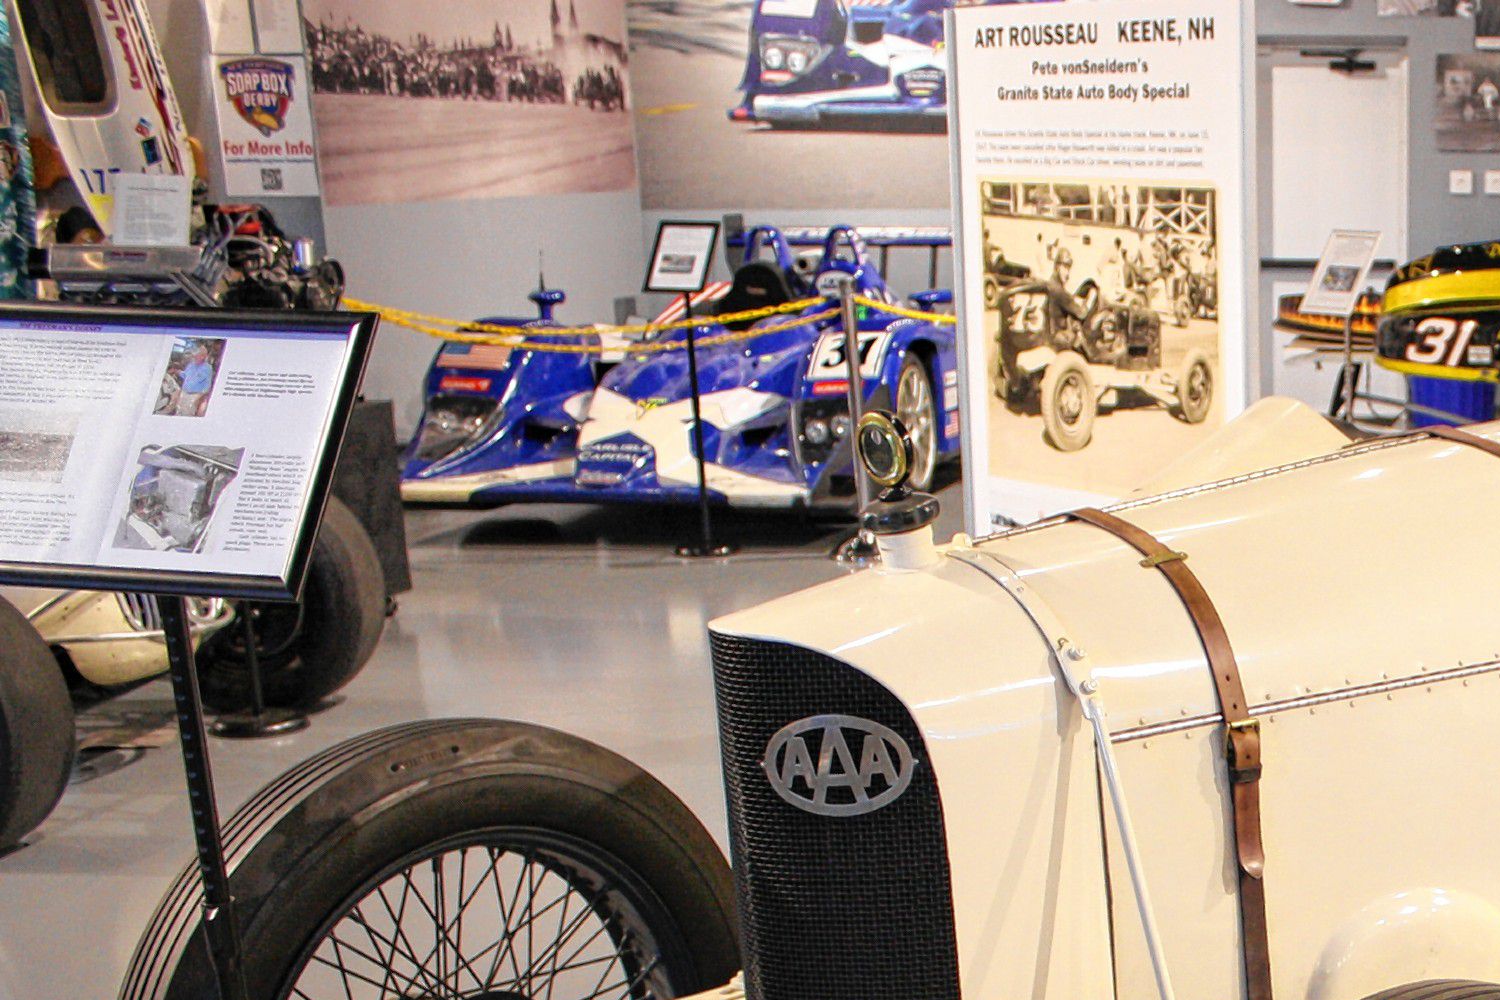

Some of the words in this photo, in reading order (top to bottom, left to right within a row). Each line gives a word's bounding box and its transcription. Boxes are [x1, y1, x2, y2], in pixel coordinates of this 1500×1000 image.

[975, 26, 1004, 48] ART
[1009, 22, 1098, 46] ROUSSEAU
[1117, 18, 1182, 45] KEENE,
[1187, 16, 1215, 41] NH
[1032, 60, 1058, 75] Pete
[262, 73, 289, 97] BOX
[998, 86, 1038, 101] Granite
[1042, 85, 1073, 100] State
[1077, 84, 1104, 100] Auto
[1108, 82, 1138, 102] Body
[1142, 82, 1190, 102] Special
[223, 140, 244, 156] For
[248, 141, 282, 156] More
[285, 140, 314, 156] Info
[1008, 292, 1049, 333] 73
[1405, 317, 1478, 367] 31
[780, 723, 901, 806] AAA
